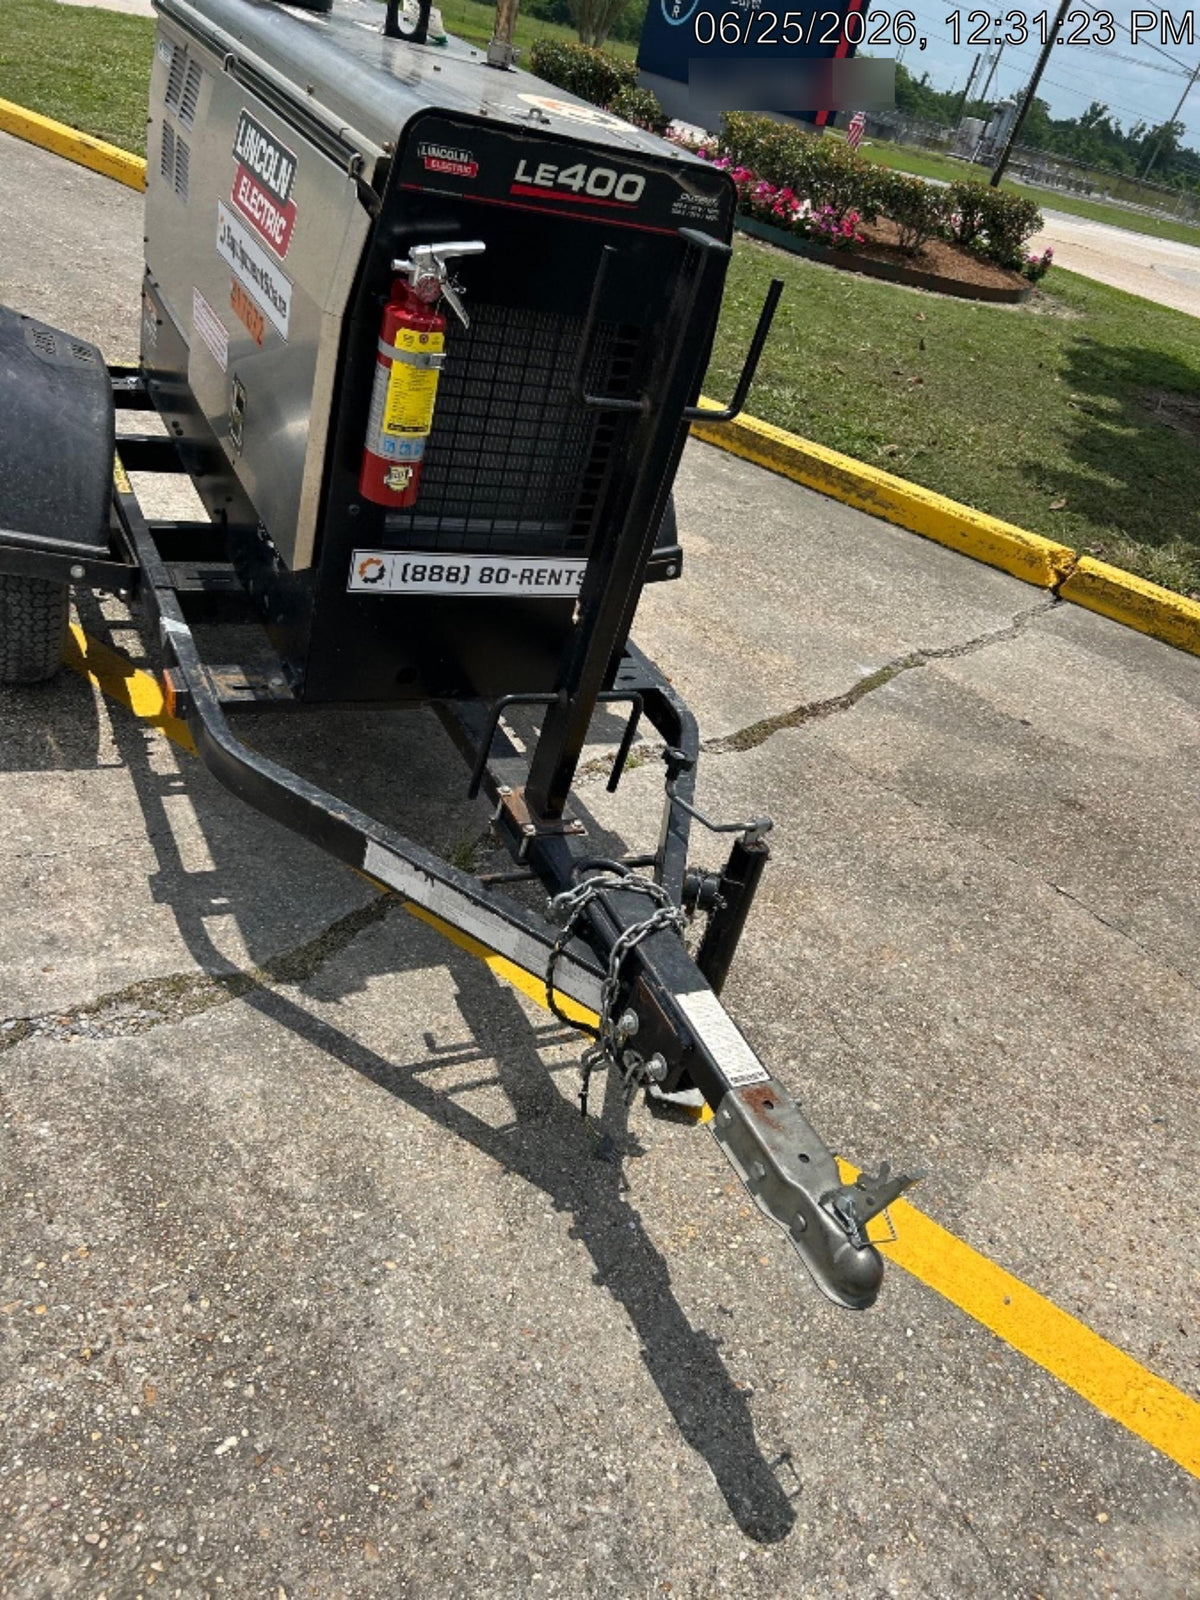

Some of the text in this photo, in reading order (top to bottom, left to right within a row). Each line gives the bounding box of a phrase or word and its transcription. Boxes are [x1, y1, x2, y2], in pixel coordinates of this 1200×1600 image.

[236, 119, 293, 200] LINCOLN
[421, 145, 469, 163] LINCOLN
[514, 159, 646, 202] LE400
[238, 175, 287, 245] ELECTRIC
[401, 563, 470, 585] (888)
